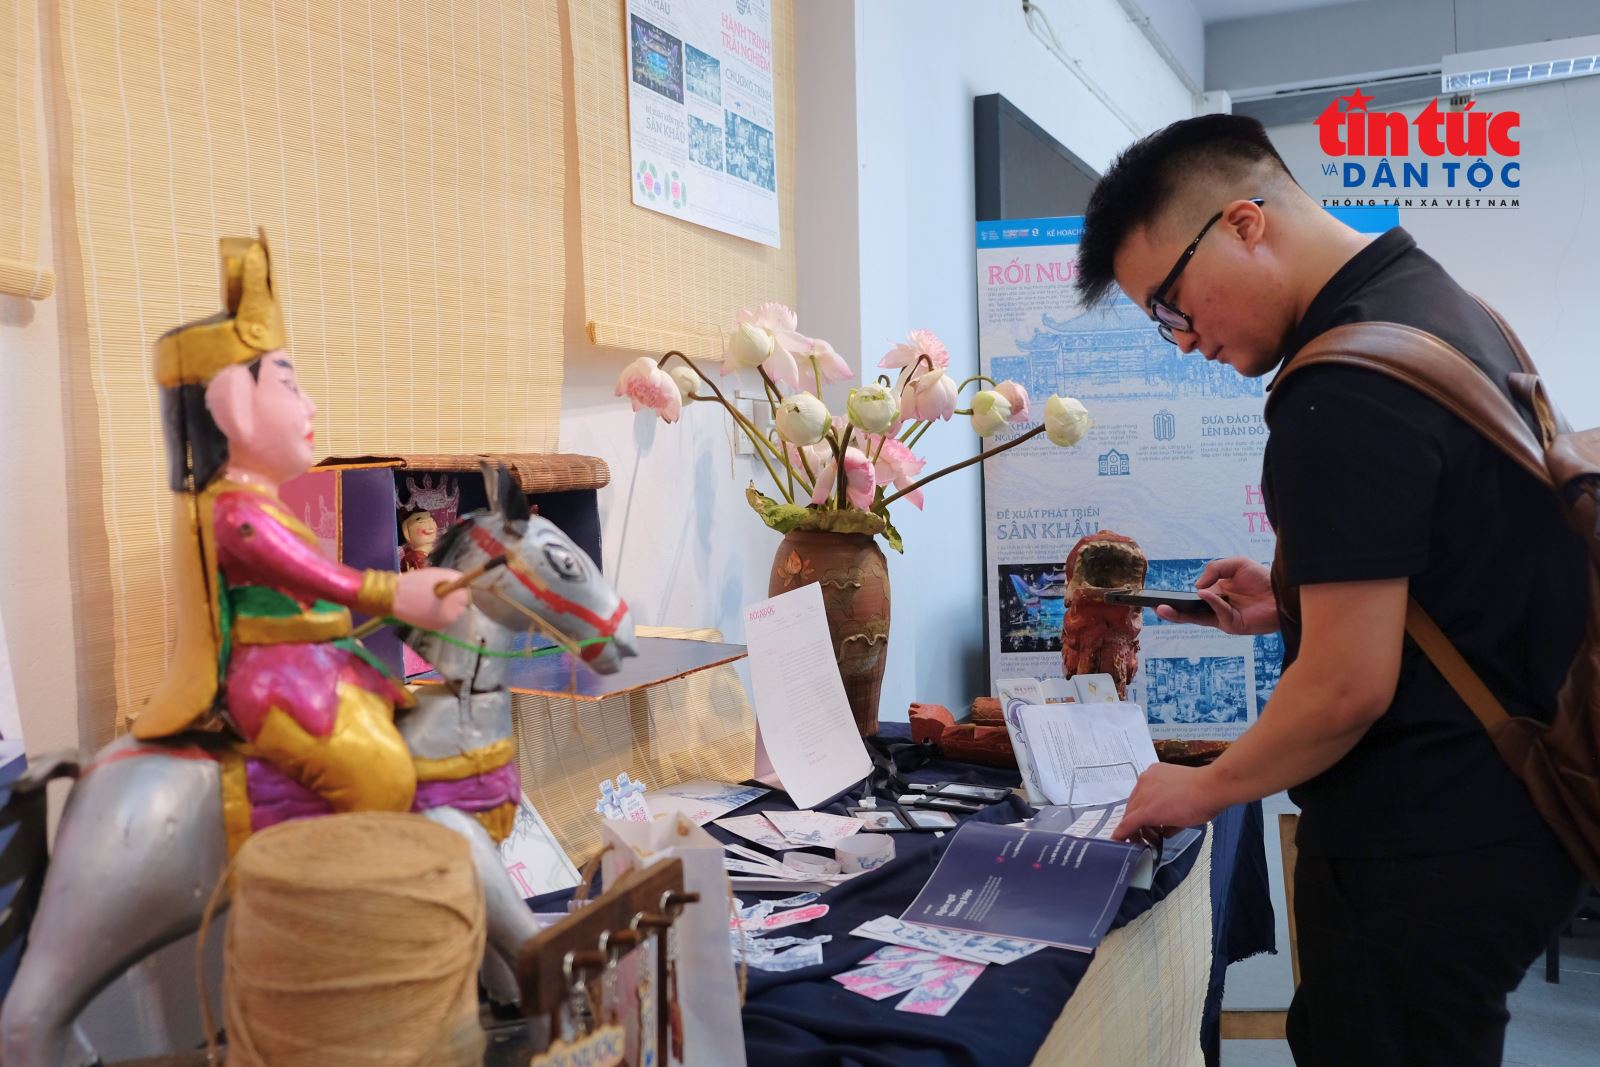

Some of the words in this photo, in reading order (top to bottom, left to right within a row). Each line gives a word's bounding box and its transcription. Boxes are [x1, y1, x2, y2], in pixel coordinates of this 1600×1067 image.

[988, 257, 1031, 285] RỐI
[1201, 414, 1224, 425] ĐƯA
[1226, 413, 1250, 424] ĐÀO
[1202, 425, 1221, 436] LÊN
[1223, 424, 1246, 436] BẢN
[996, 508, 1010, 520] ĐỀ
[1012, 507, 1040, 519] XUẤT
[1041, 507, 1069, 518] PHÁT
[1071, 505, 1100, 518] TRIỂN
[997, 520, 1037, 540] SÂN
